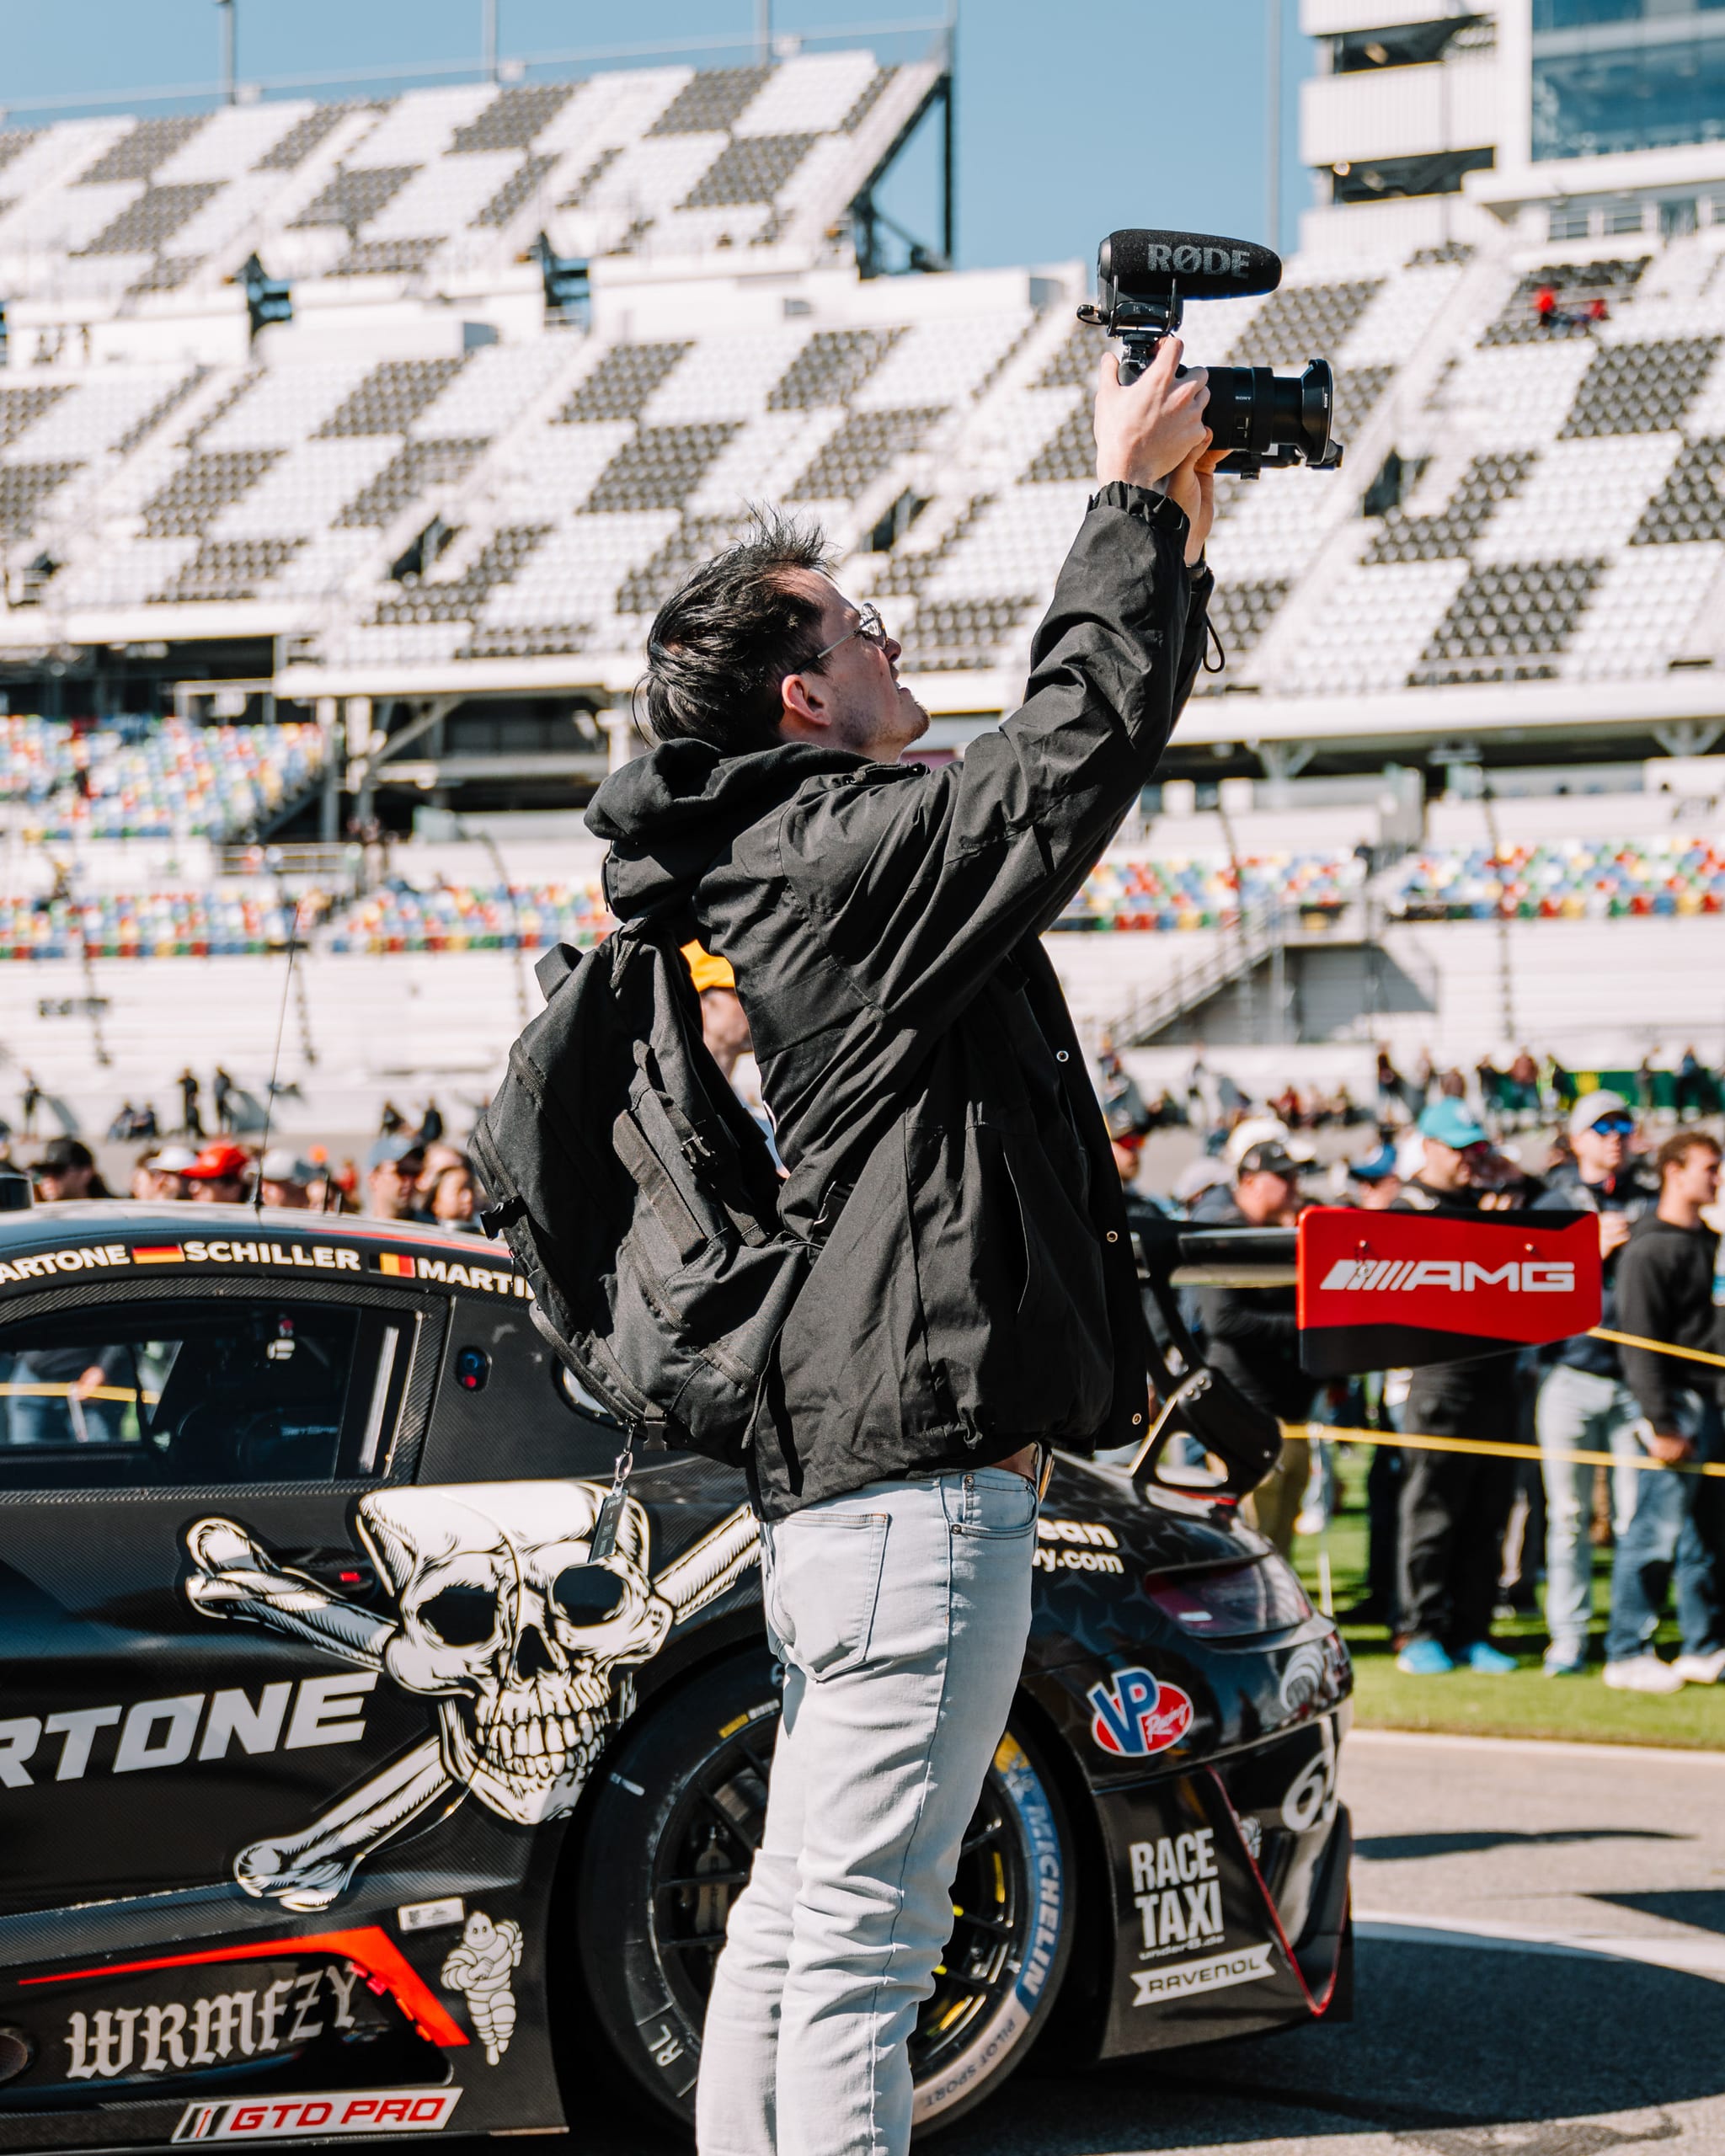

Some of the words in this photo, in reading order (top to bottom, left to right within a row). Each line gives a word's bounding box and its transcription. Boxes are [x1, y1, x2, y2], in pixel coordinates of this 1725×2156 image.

[1147, 243, 1250, 280] RØDE
[0, 1244, 130, 1284] ARTONE
[184, 1241, 361, 1271] SCHILLER
[0, 1671, 378, 1788] RTONE
[1088, 1668, 1158, 1755] VP
[1130, 1828, 1218, 1892] RACE
[1023, 1806, 1060, 1997] MICHELIN
[1135, 1880, 1224, 1949] TAXI
[980, 2018, 1016, 2064] PILOT
[926, 2064, 977, 2105] SPORT
[230, 2102, 334, 2132] GTD
[340, 2098, 446, 2125] PRO
